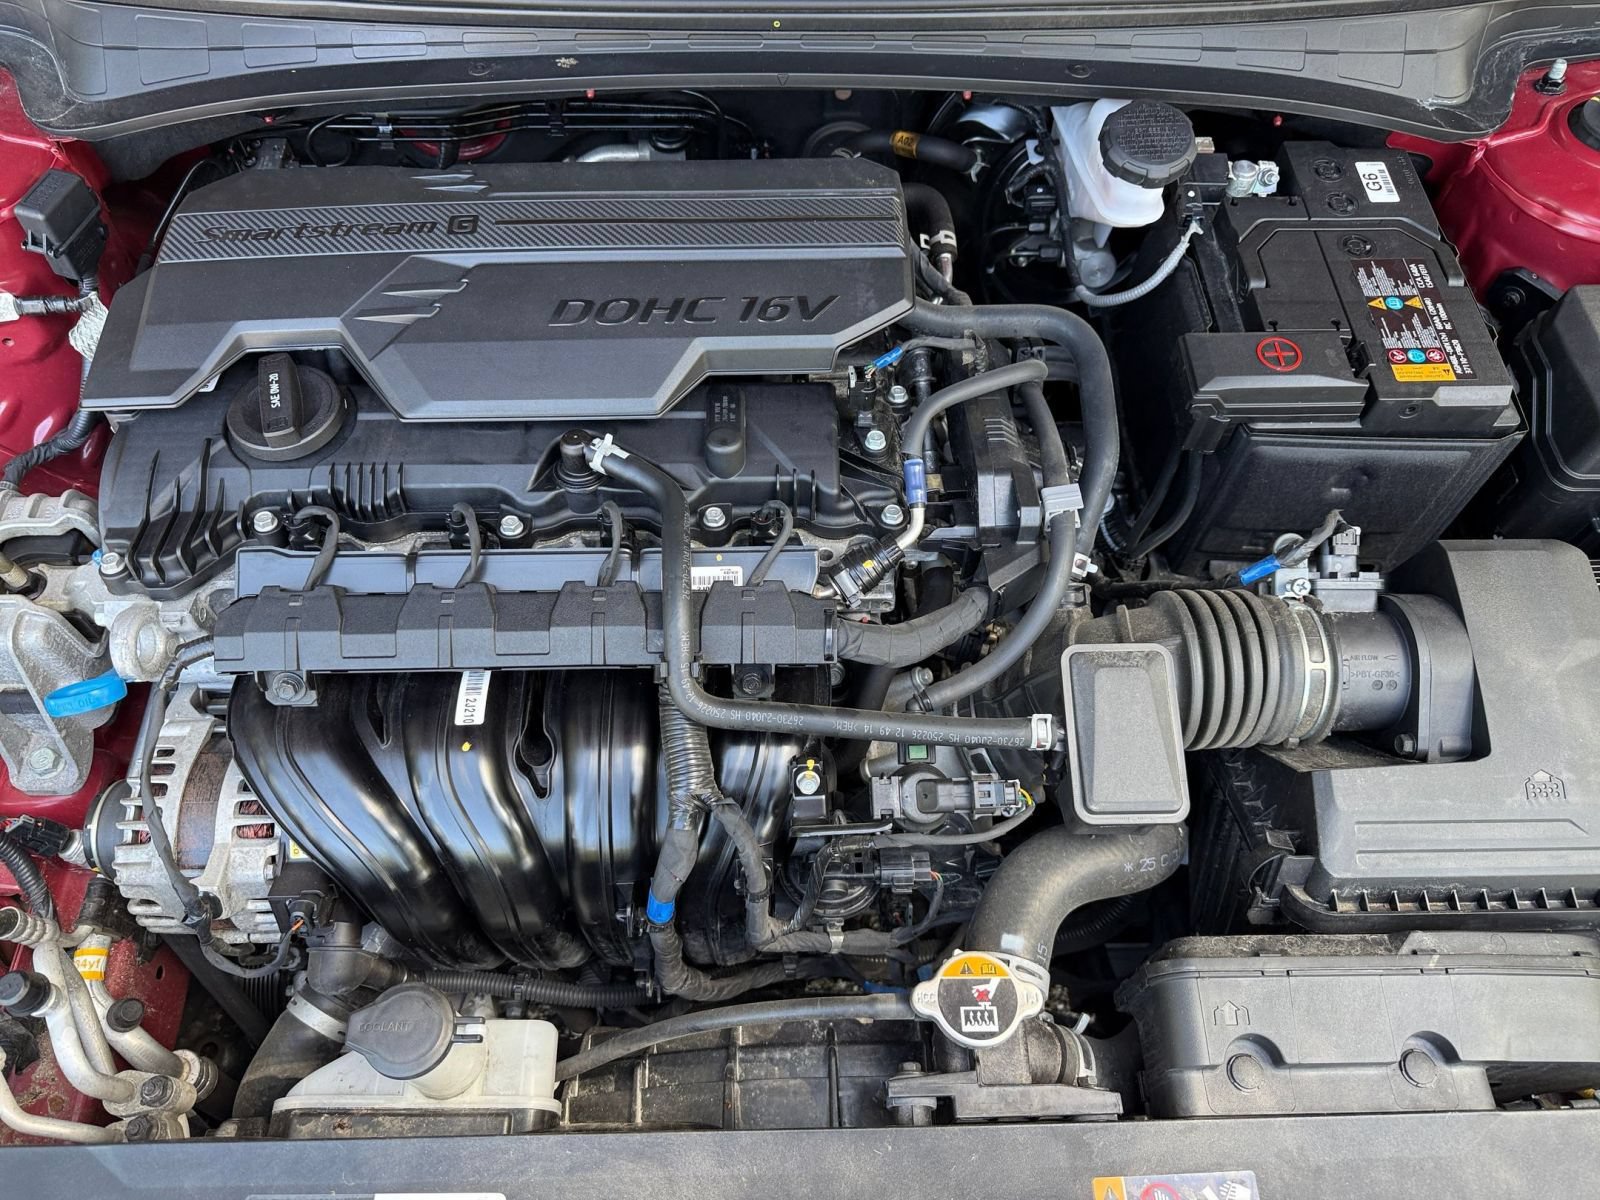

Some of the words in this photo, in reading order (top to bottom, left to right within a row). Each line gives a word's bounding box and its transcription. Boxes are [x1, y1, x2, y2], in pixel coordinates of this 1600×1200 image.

[1363, 172, 1382, 192] G6
[195, 219, 438, 244] Smartstream
[1413, 276, 1425, 287] CCA
[548, 296, 726, 327] DOHC
[739, 295, 841, 324] 16V
[269, 373, 280, 394] 0W-20
[270, 394, 281, 409] SAE
[463, 698, 477, 723] 2J210
[730, 710, 741, 720] HS
[911, 729, 943, 742] 250226
[948, 733, 960, 743] HS
[964, 734, 1025, 747] 26730-2J040
[1140, 857, 1156, 871] 25
[359, 1021, 411, 1033] COOLANT
